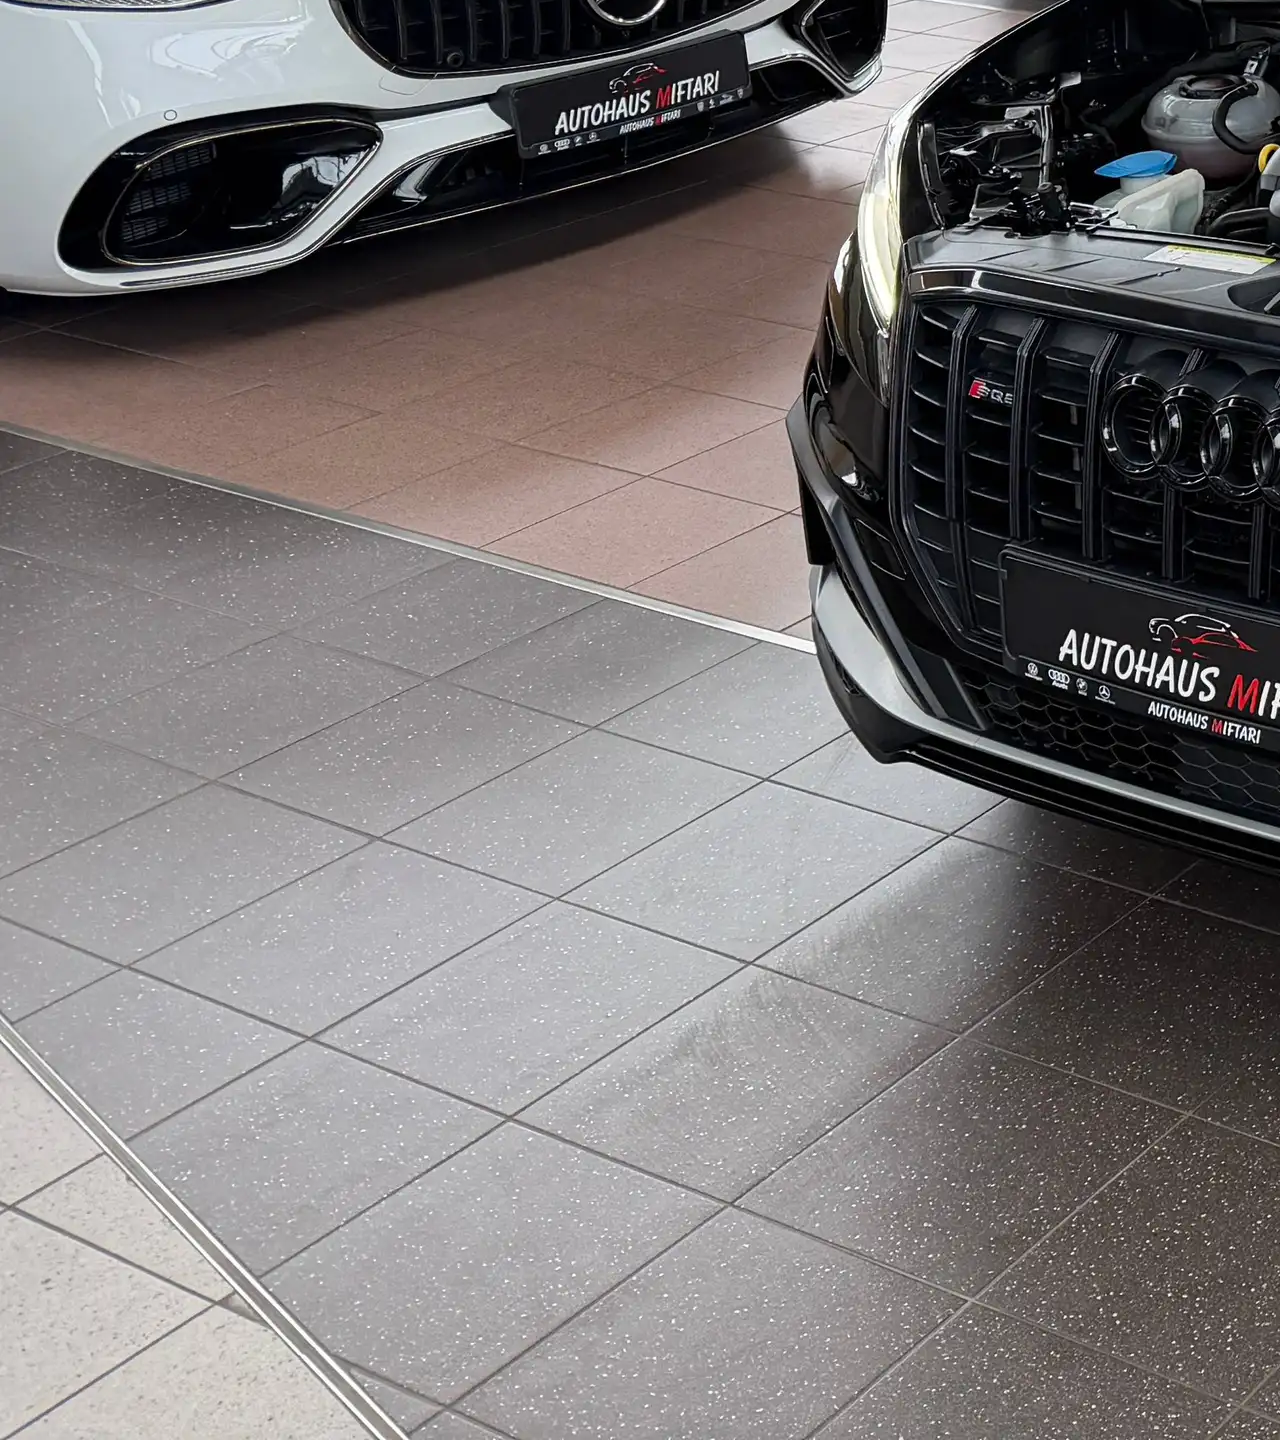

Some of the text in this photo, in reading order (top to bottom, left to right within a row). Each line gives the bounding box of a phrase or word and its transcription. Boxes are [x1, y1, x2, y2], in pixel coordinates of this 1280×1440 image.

[554, 70, 720, 136] AUTOHAUS MIFTARI
[619, 117, 655, 135] AUTOHAUS
[1058, 628, 1221, 702] AUTOHAUS
[1147, 701, 1262, 744] AUTOHAUS MIFTARI
